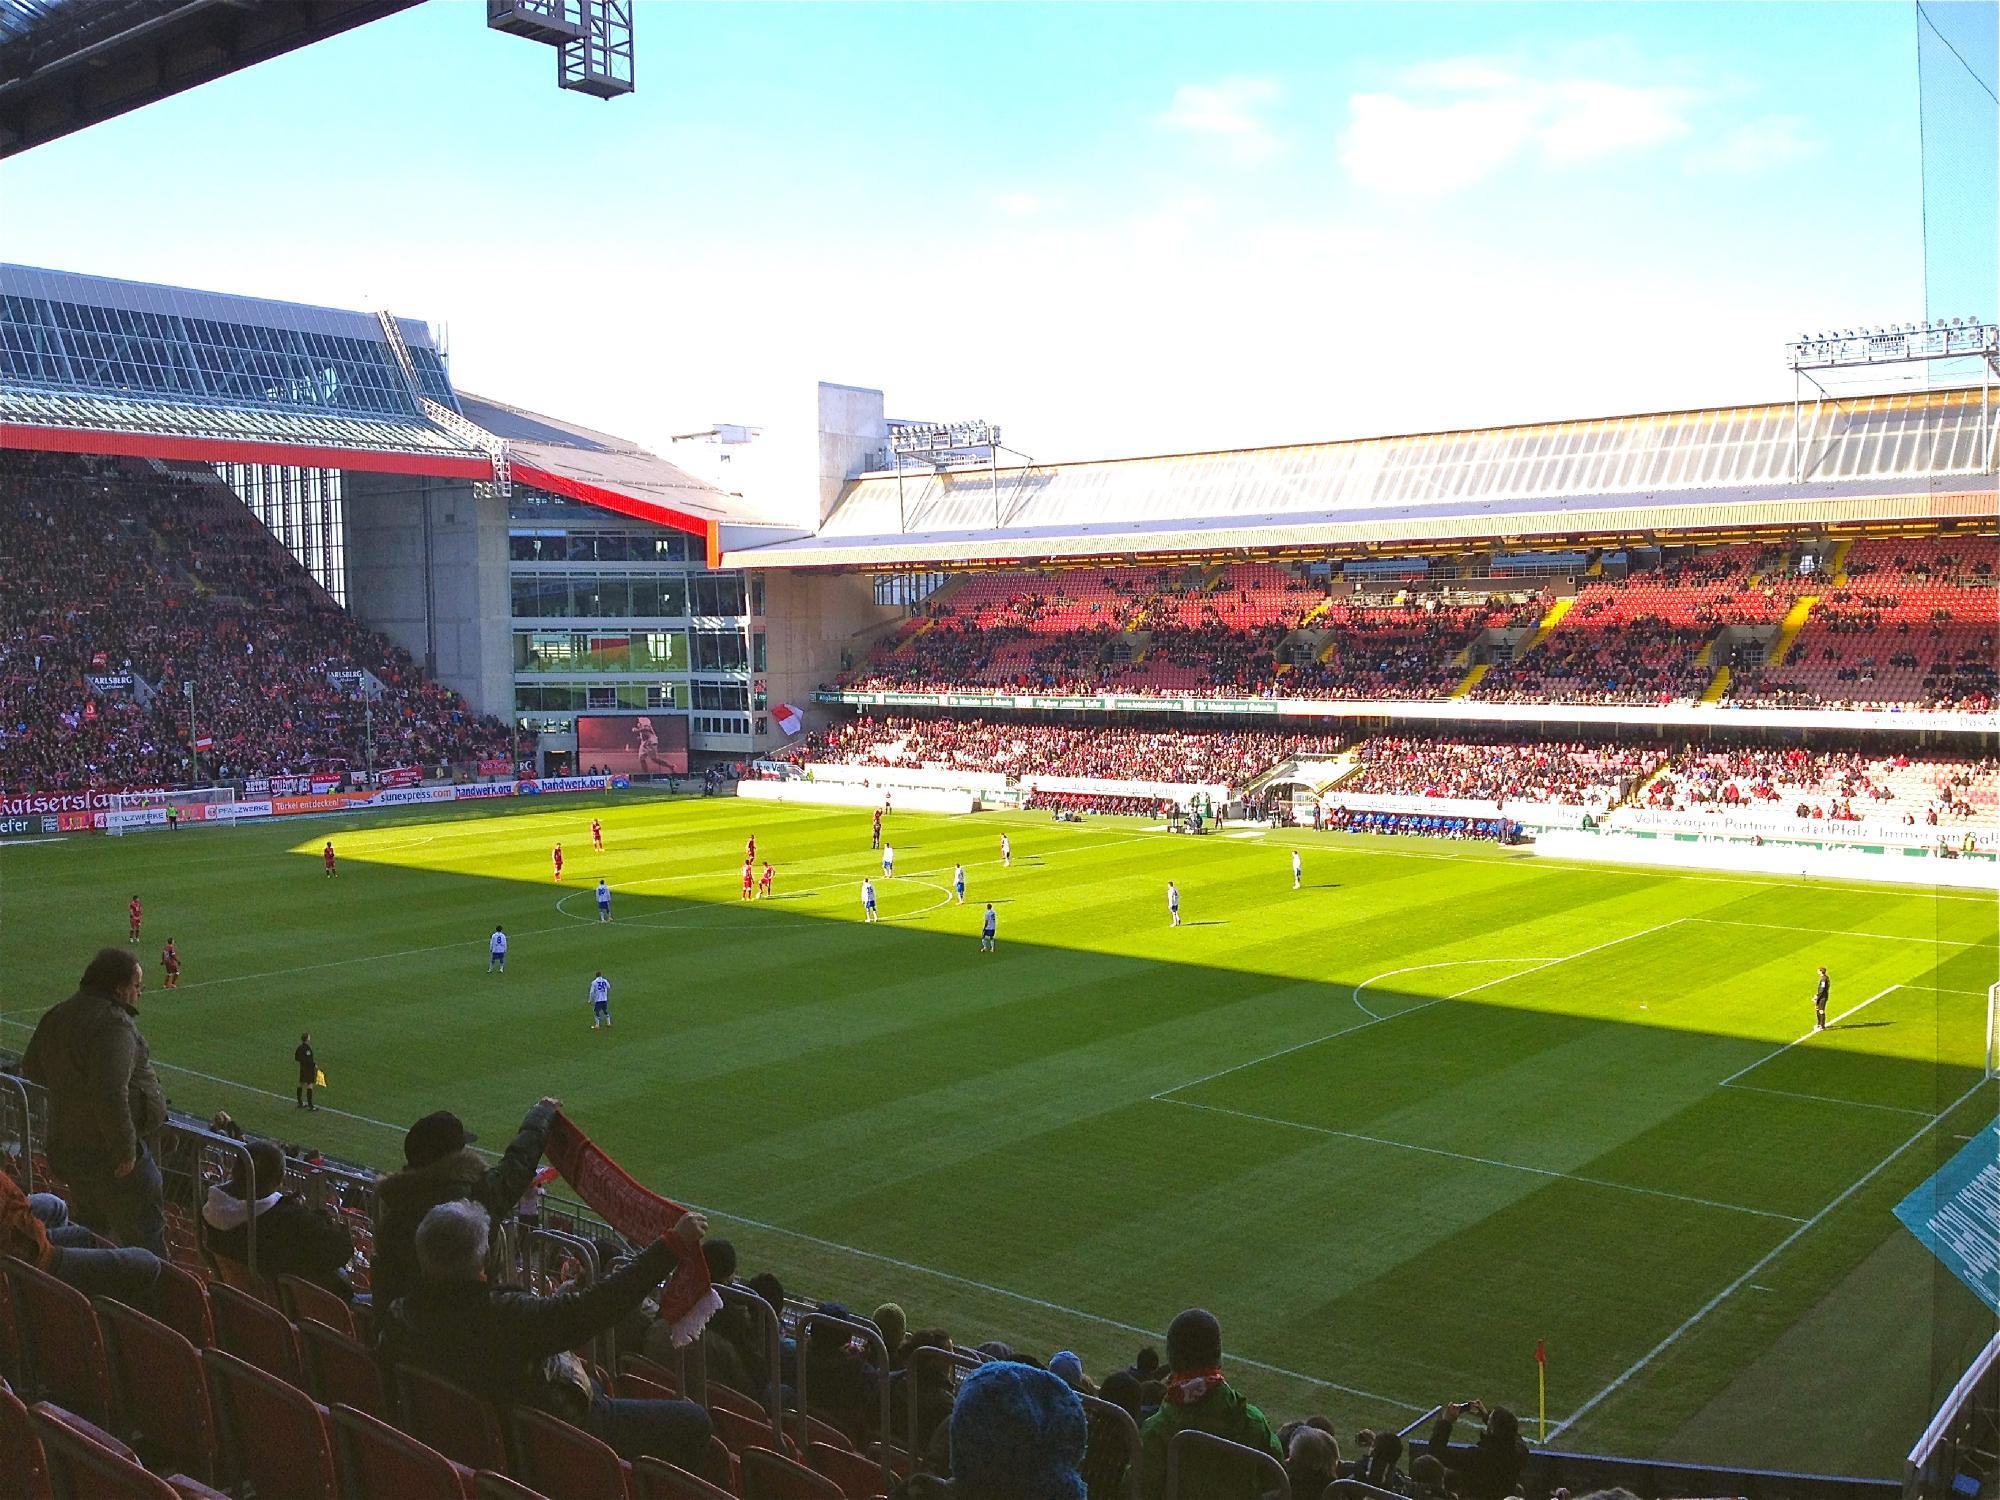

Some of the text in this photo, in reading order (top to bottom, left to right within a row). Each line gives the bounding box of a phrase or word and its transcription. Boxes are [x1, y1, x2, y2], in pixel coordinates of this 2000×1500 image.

[91, 676, 133, 684] ARLSBERG
[541, 777, 605, 791] handwerk.org
[380, 789, 452, 803] sunexpress.com
[455, 785, 512, 797] handwerk.org
[217, 804, 270, 815] PFALZWERKE
[110, 812, 164, 823] PFALZWERKE
[1725, 817, 1776, 832] Partner
